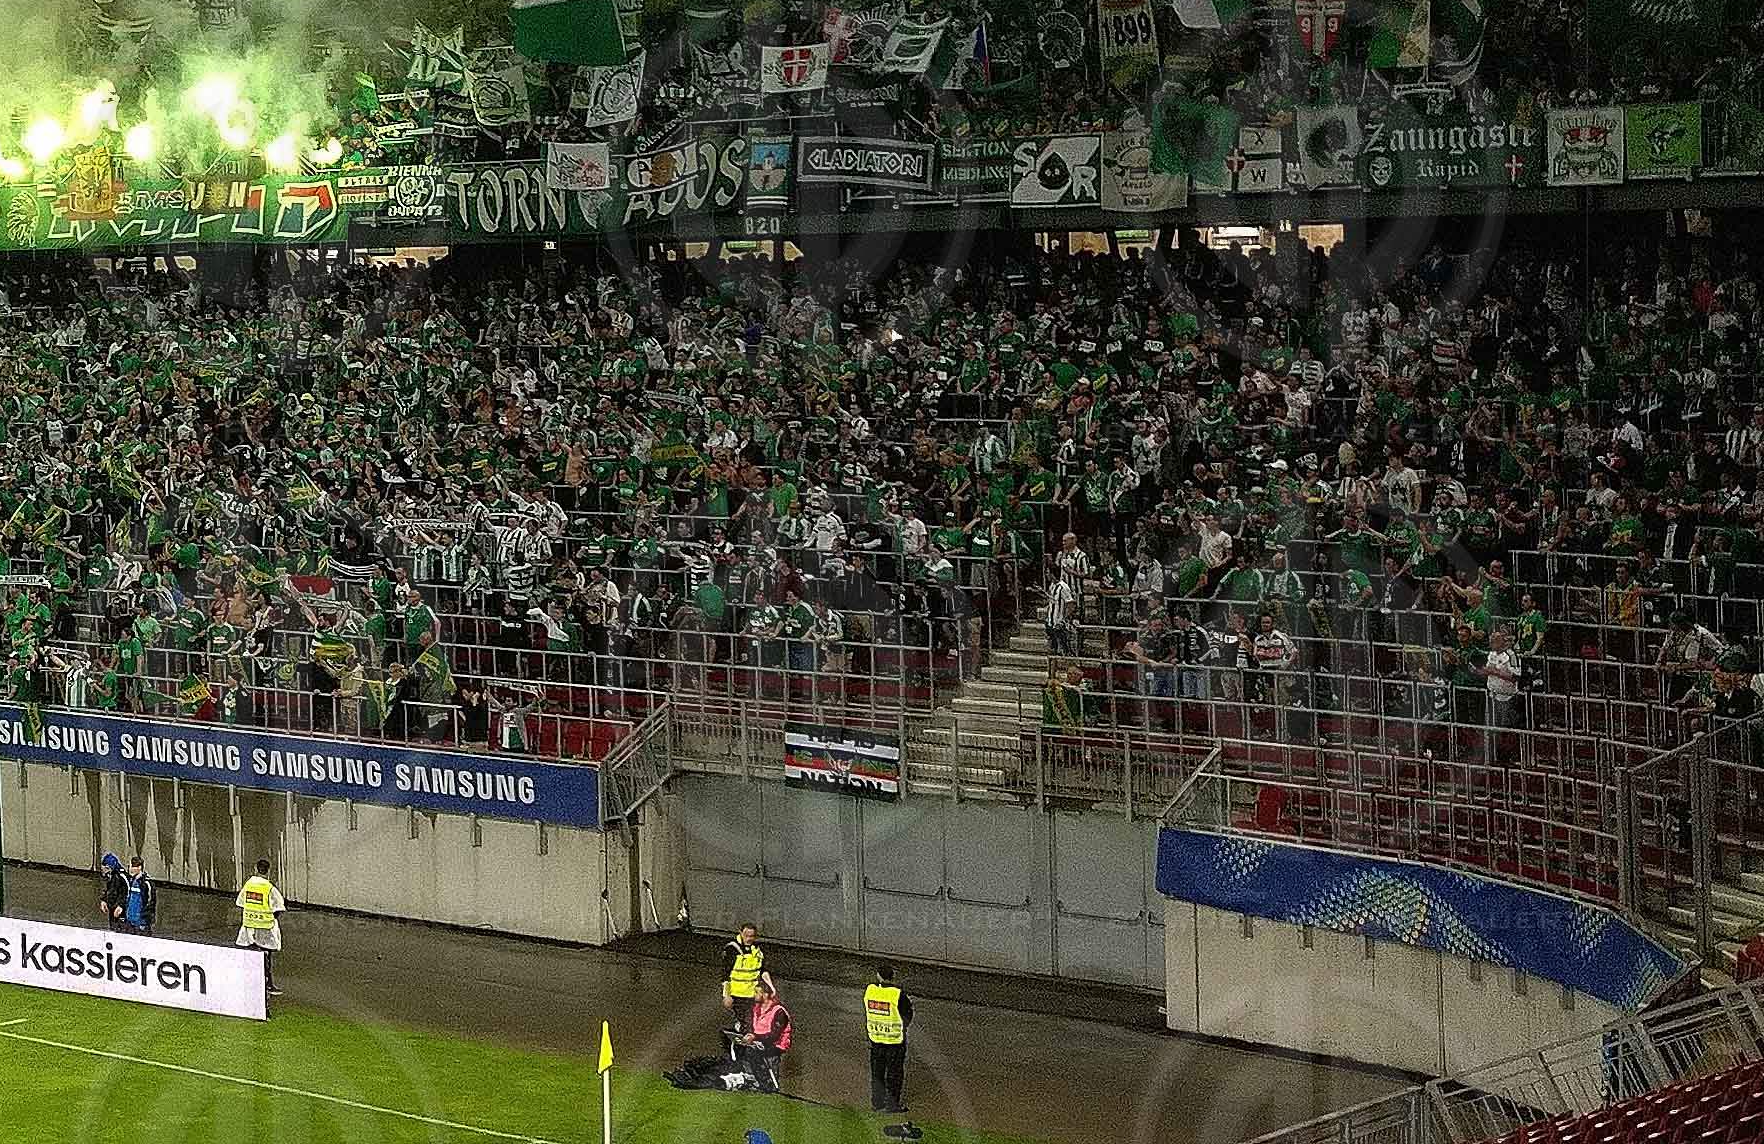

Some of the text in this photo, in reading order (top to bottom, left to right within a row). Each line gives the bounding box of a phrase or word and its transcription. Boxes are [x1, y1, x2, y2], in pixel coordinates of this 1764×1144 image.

[1101, 12, 1151, 48] 1899
[1363, 117, 1536, 154] Zaungäste
[807, 148, 923, 178] GLADIATORI
[1416, 157, 1480, 181] Rapid
[120, 733, 240, 771] SAMSUNG
[252, 748, 382, 787] SAMSUNG
[395, 763, 535, 804] SAMSUNG
[21, 935, 208, 995] kassieren
